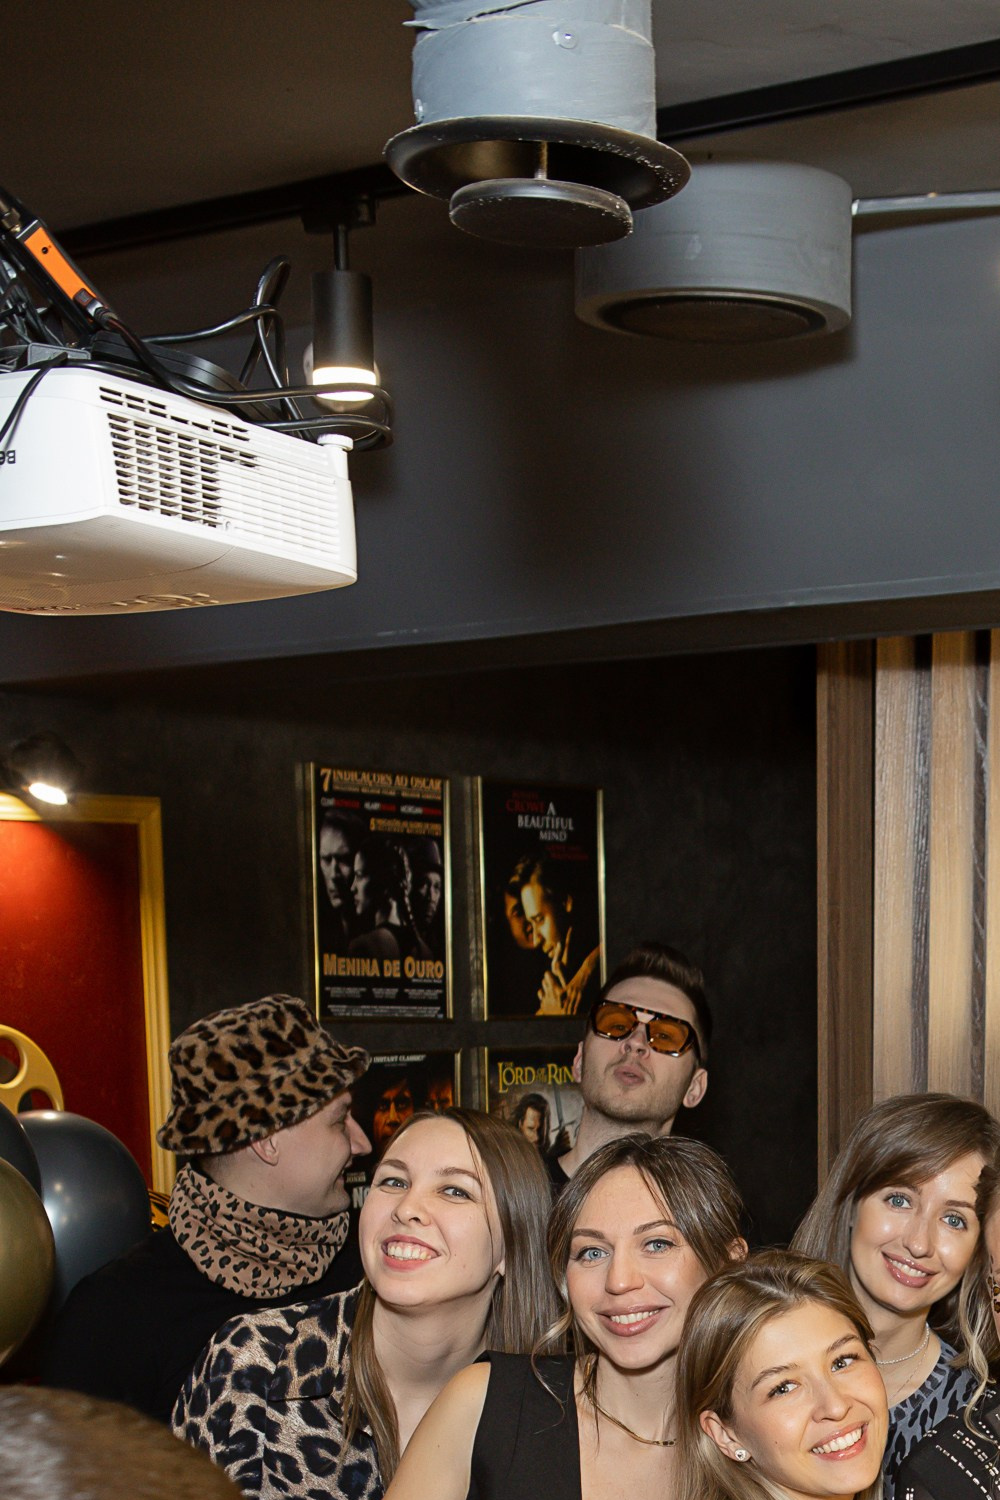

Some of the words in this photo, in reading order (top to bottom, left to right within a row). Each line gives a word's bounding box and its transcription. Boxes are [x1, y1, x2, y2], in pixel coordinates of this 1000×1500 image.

[320, 767, 332, 792] 7
[546, 801, 556, 816] A
[517, 814, 574, 830] BEAUTIFUL
[539, 830, 567, 841] MIND
[323, 953, 380, 976] MENINA
[383, 959, 401, 977] DE
[404, 956, 444, 979] OURO
[497, 1061, 536, 1093] LORD
[547, 1063, 575, 1085] RIN
